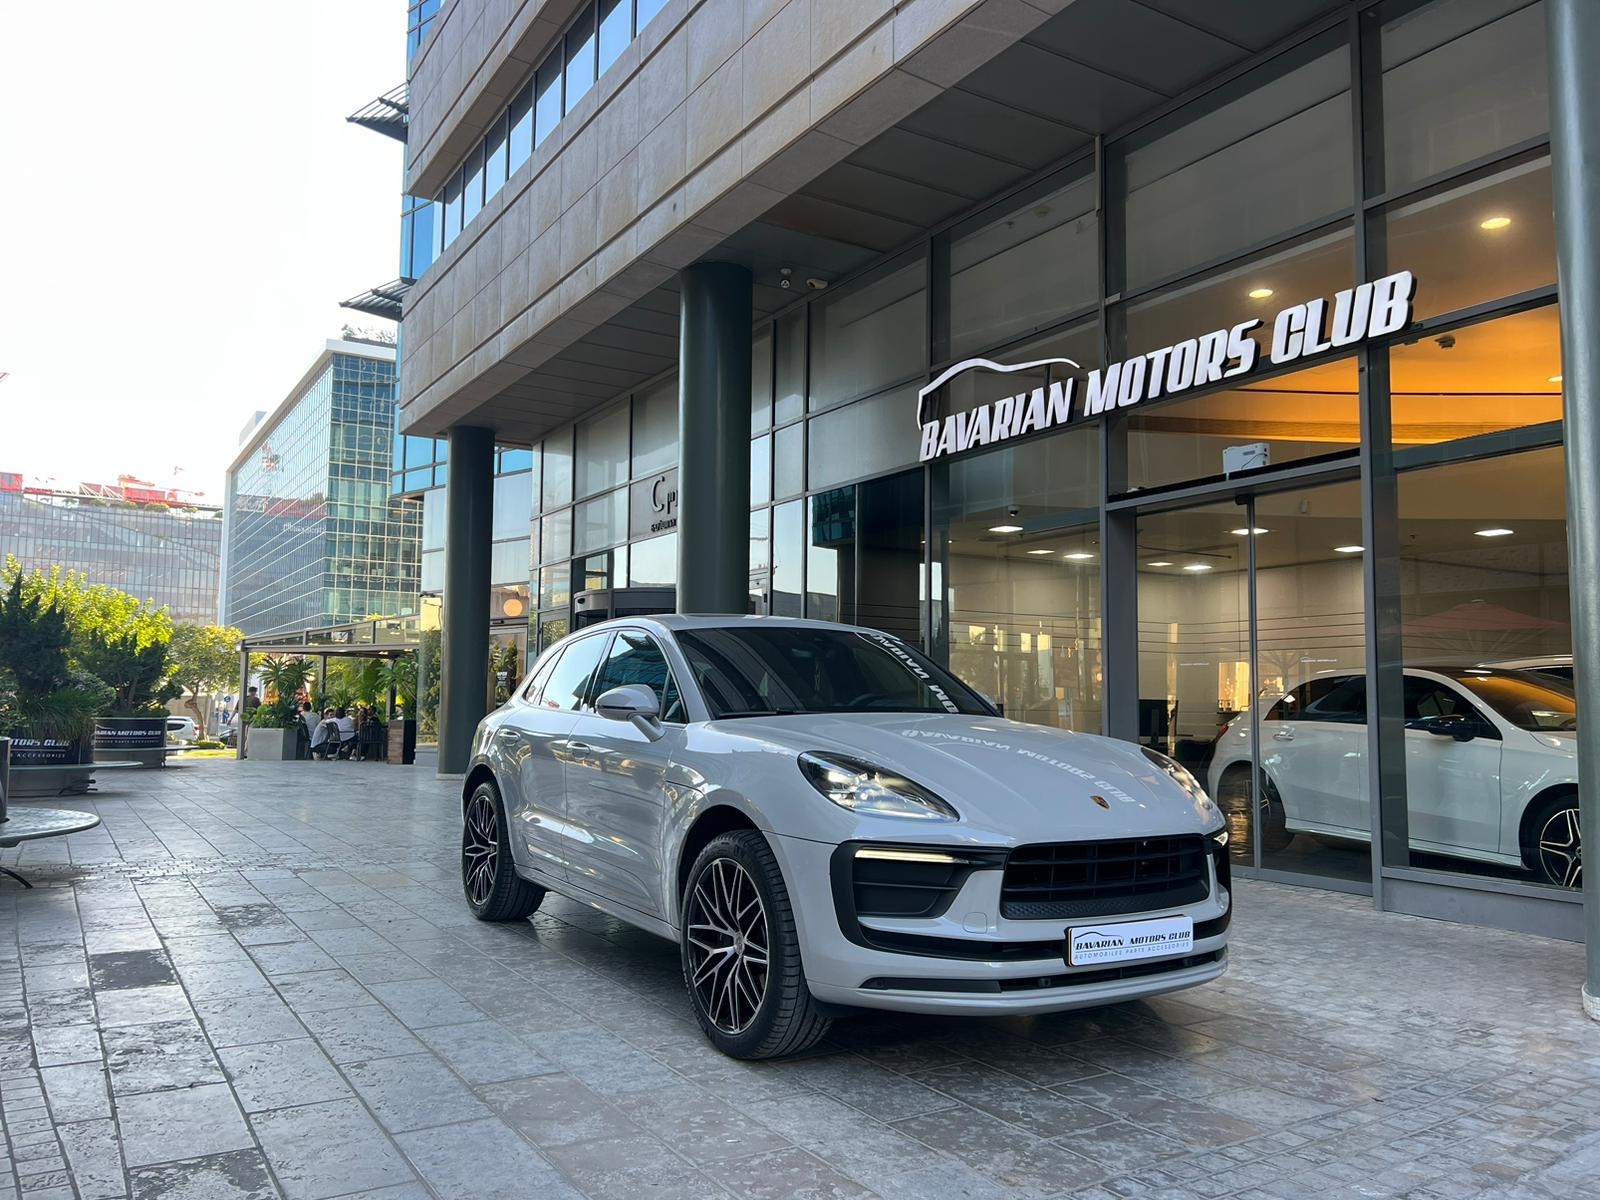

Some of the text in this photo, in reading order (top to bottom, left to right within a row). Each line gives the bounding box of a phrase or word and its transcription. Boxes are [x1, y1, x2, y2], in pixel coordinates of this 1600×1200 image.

[919, 270, 1416, 463] BAVARIAN MOTORS CLUB
[1076, 931, 1191, 950] BAVARIAN MOTORS CLUB
[1074, 949, 1122, 960] AUTOMOBILES
[1148, 941, 1189, 952] ACCESSORIES
